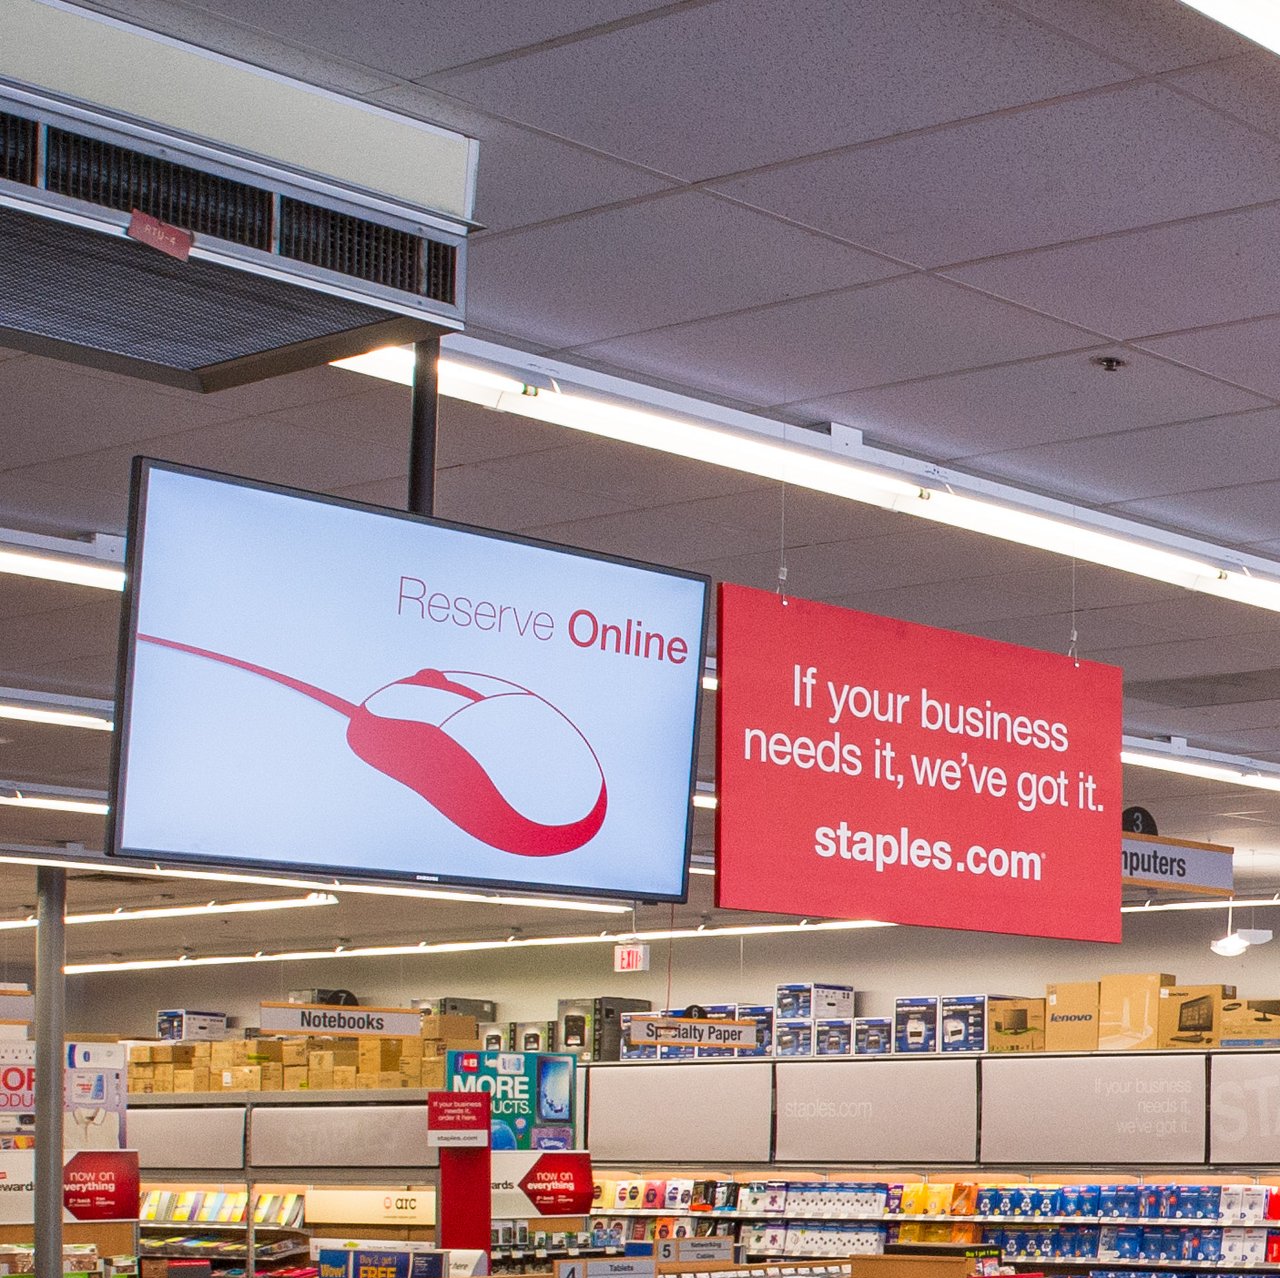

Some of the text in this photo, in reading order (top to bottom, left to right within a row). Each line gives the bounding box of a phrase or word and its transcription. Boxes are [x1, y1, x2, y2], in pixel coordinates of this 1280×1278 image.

[398, 574, 689, 667] Reserve Online
[792, 664, 1068, 754] If your business
[743, 724, 1104, 813] needs it, we've got it.
[1133, 812, 1143, 833] 3
[814, 821, 1043, 882] staples.com
[620, 949, 640, 970] EXIT
[692, 1007, 699, 1019] 6
[1049, 1012, 1093, 1024] lenovo
[301, 1010, 384, 1032] Notebooks
[708, 1025, 743, 1044] Paper
[453, 1075, 530, 1099] MORE
[785, 1099, 873, 1121] staples.com
[70, 1172, 115, 1181] now on
[536, 1173, 573, 1181] now on
[527, 1180, 576, 1191] everything
[395, 1197, 417, 1210] arc
[662, 1243, 671, 1259] 5
[690, 1240, 722, 1249] Networking
[359, 1254, 372, 1266] Buy
[695, 1252, 716, 1260] Cables
[321, 1263, 346, 1278] Wow!
[610, 1264, 634, 1272] Tablets
